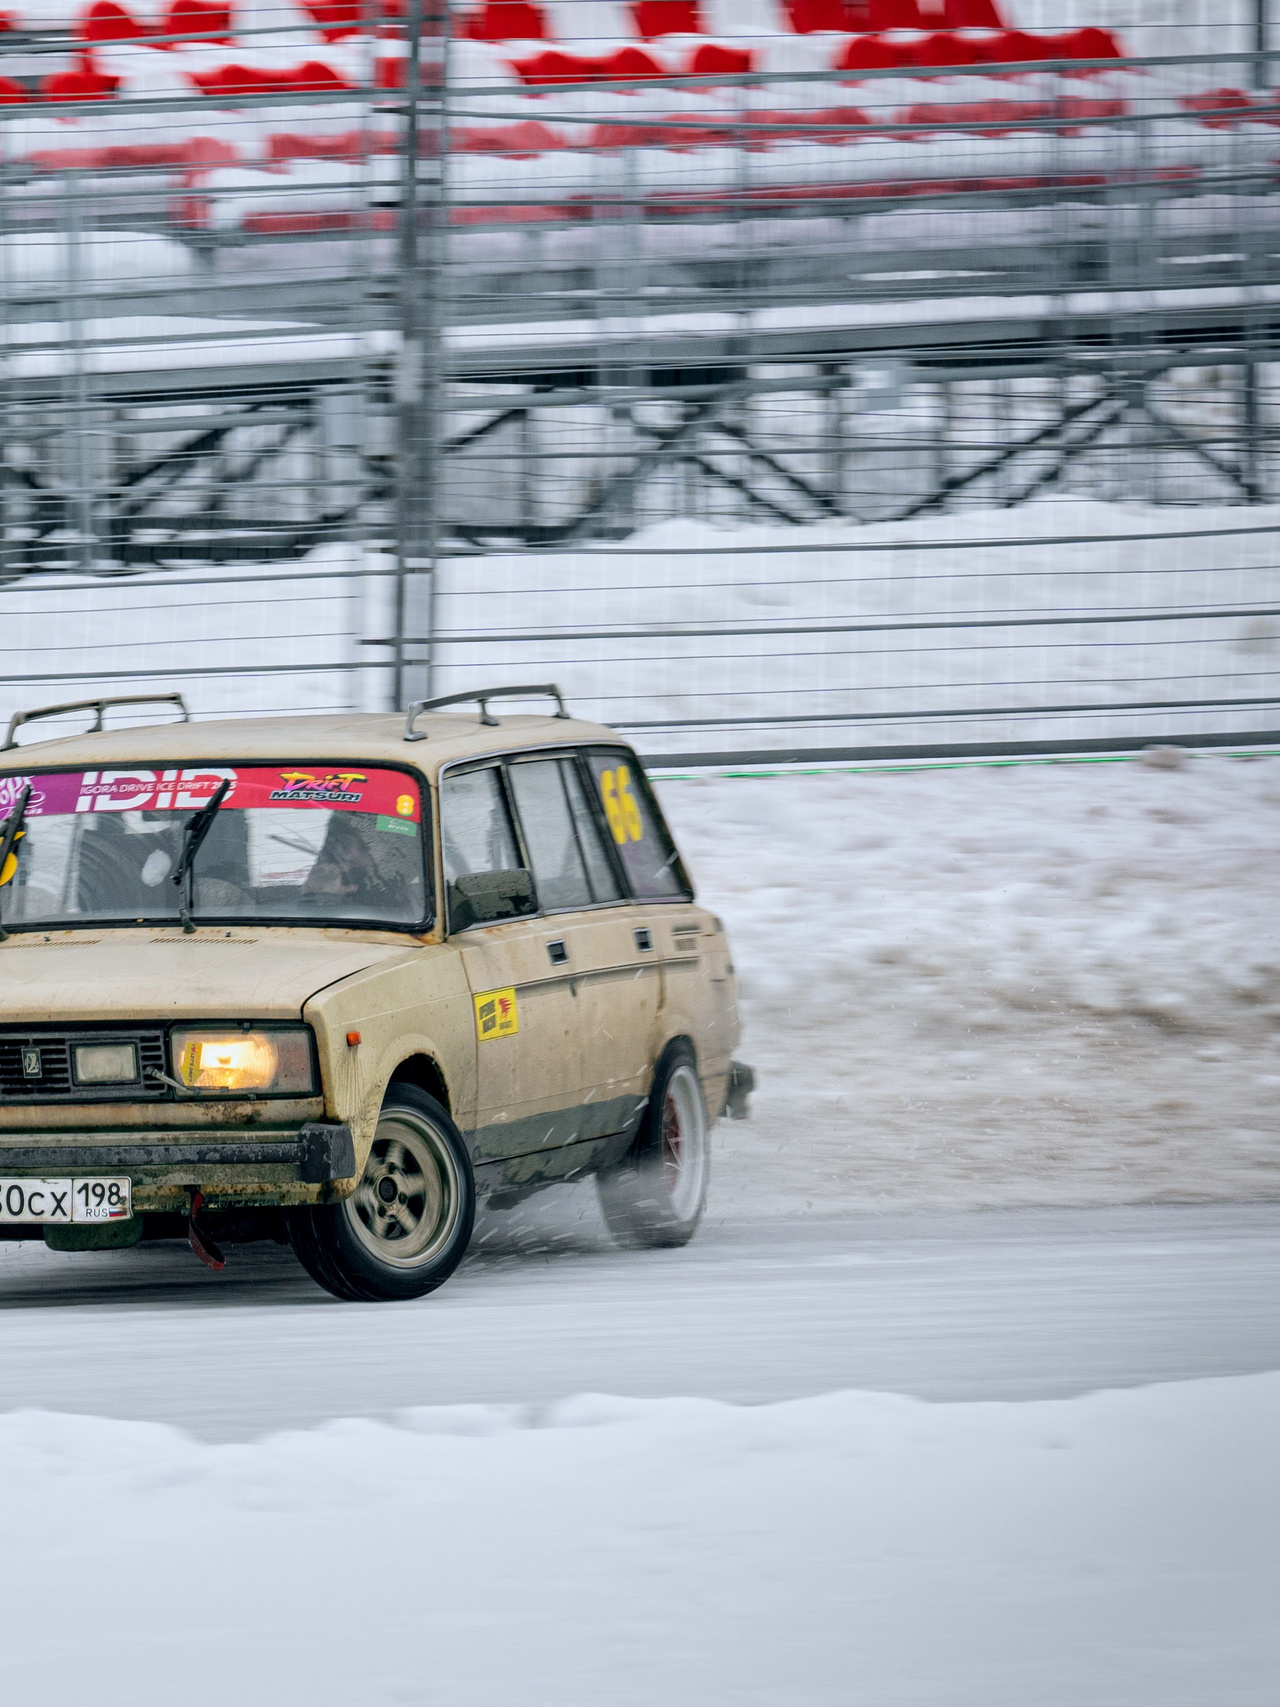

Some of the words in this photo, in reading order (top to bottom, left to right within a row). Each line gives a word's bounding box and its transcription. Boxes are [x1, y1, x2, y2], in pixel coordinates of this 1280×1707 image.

[80, 784, 118, 795] IGORA
[119, 783, 154, 793] DRIVE
[156, 782, 174, 792] ICE
[176, 781, 208, 791] DRIFT
[210, 780, 237, 790] 25
[269, 790, 363, 803] MATSURI
[77, 1182, 121, 1207] 198
[85, 1208, 108, 1218] RUS
